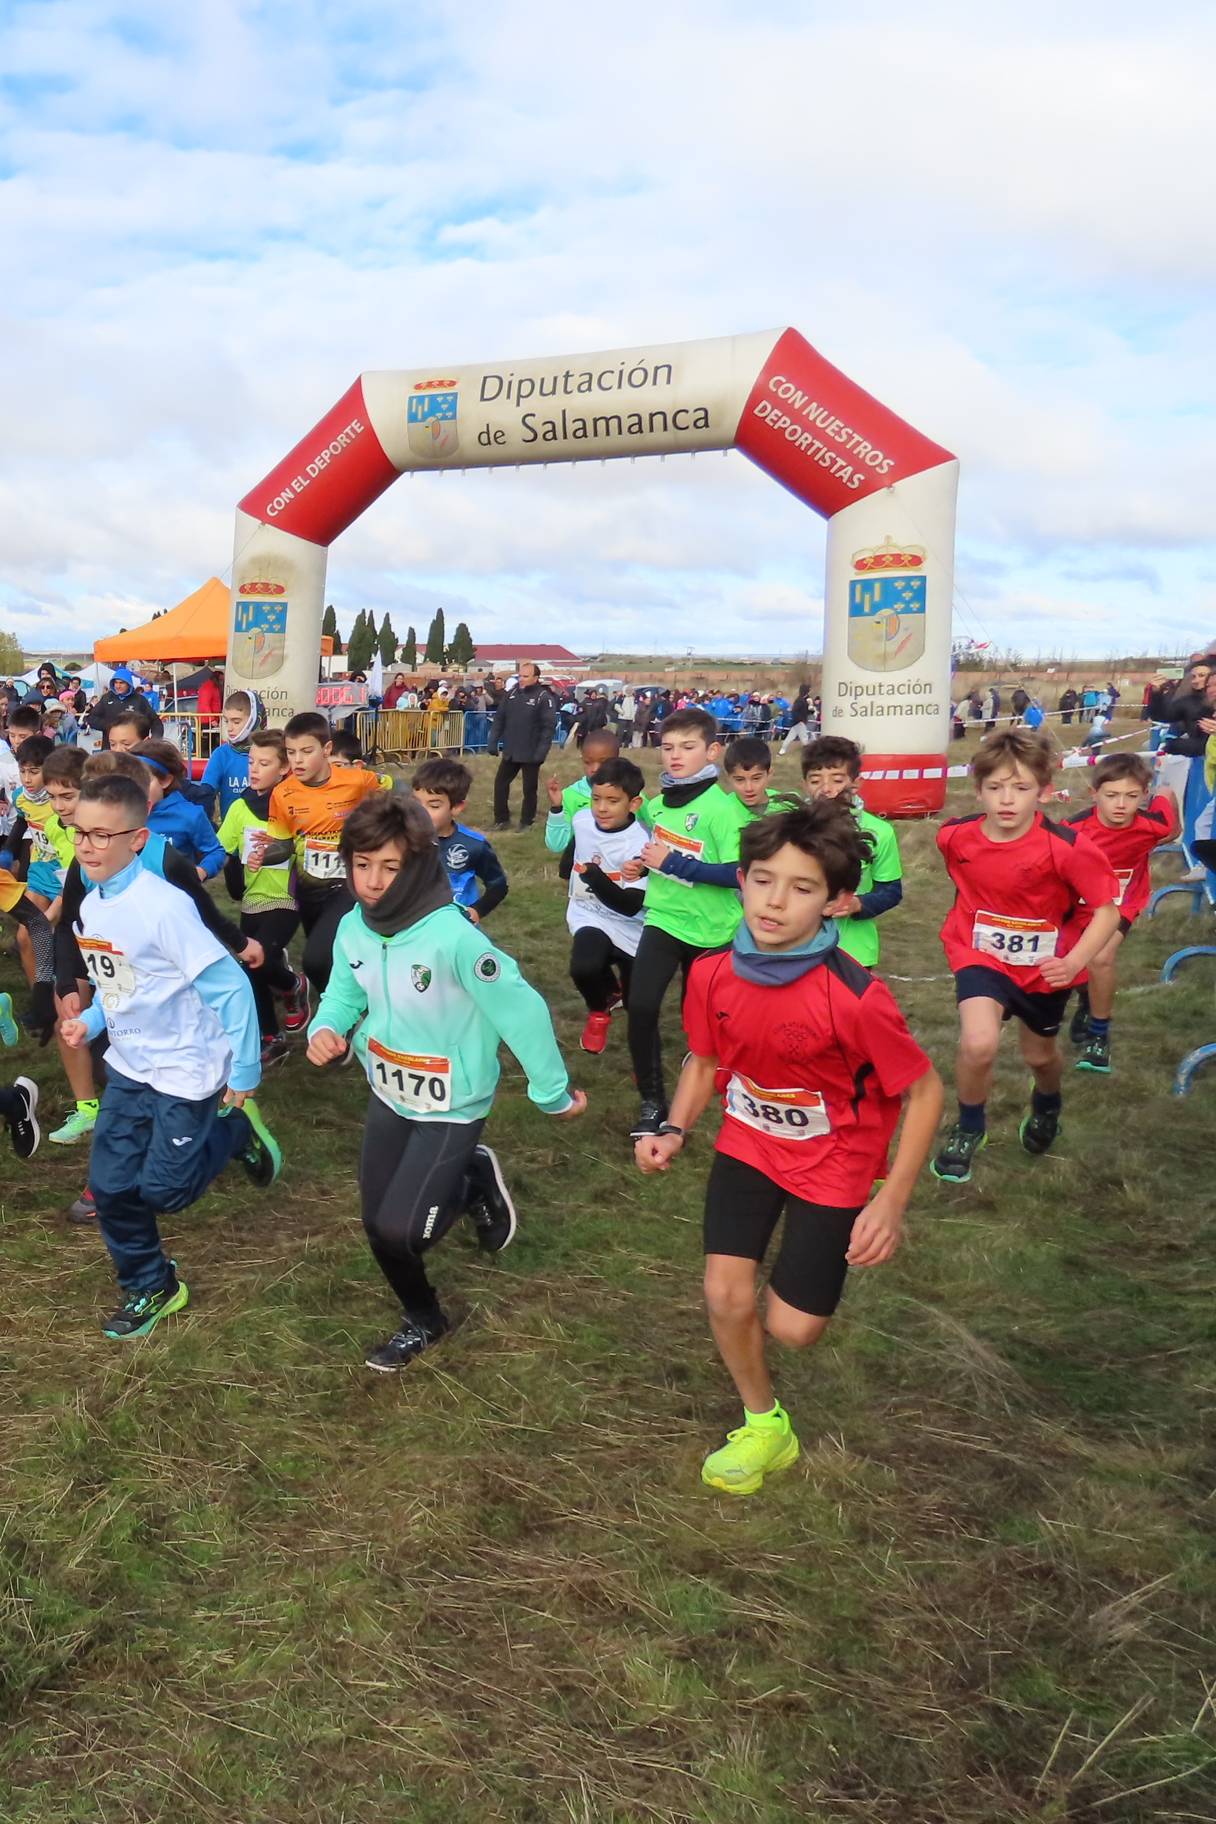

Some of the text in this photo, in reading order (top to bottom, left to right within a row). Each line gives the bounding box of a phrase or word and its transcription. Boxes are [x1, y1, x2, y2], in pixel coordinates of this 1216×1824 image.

[479, 359, 673, 407] Diputación
[478, 406, 710, 446] de Salamanca
[753, 400, 865, 489] DEPORTISTAS
[768, 375, 895, 474] CON NUESTROS
[266, 419, 365, 517] CON EL DEPORTE
[831, 700, 940, 718] de Salamanca
[837, 678, 933, 700] Diputación
[228, 776, 240, 788] LA
[991, 932, 1040, 953] 381
[376, 1062, 446, 1102] 1170
[741, 1093, 809, 1127] 380
